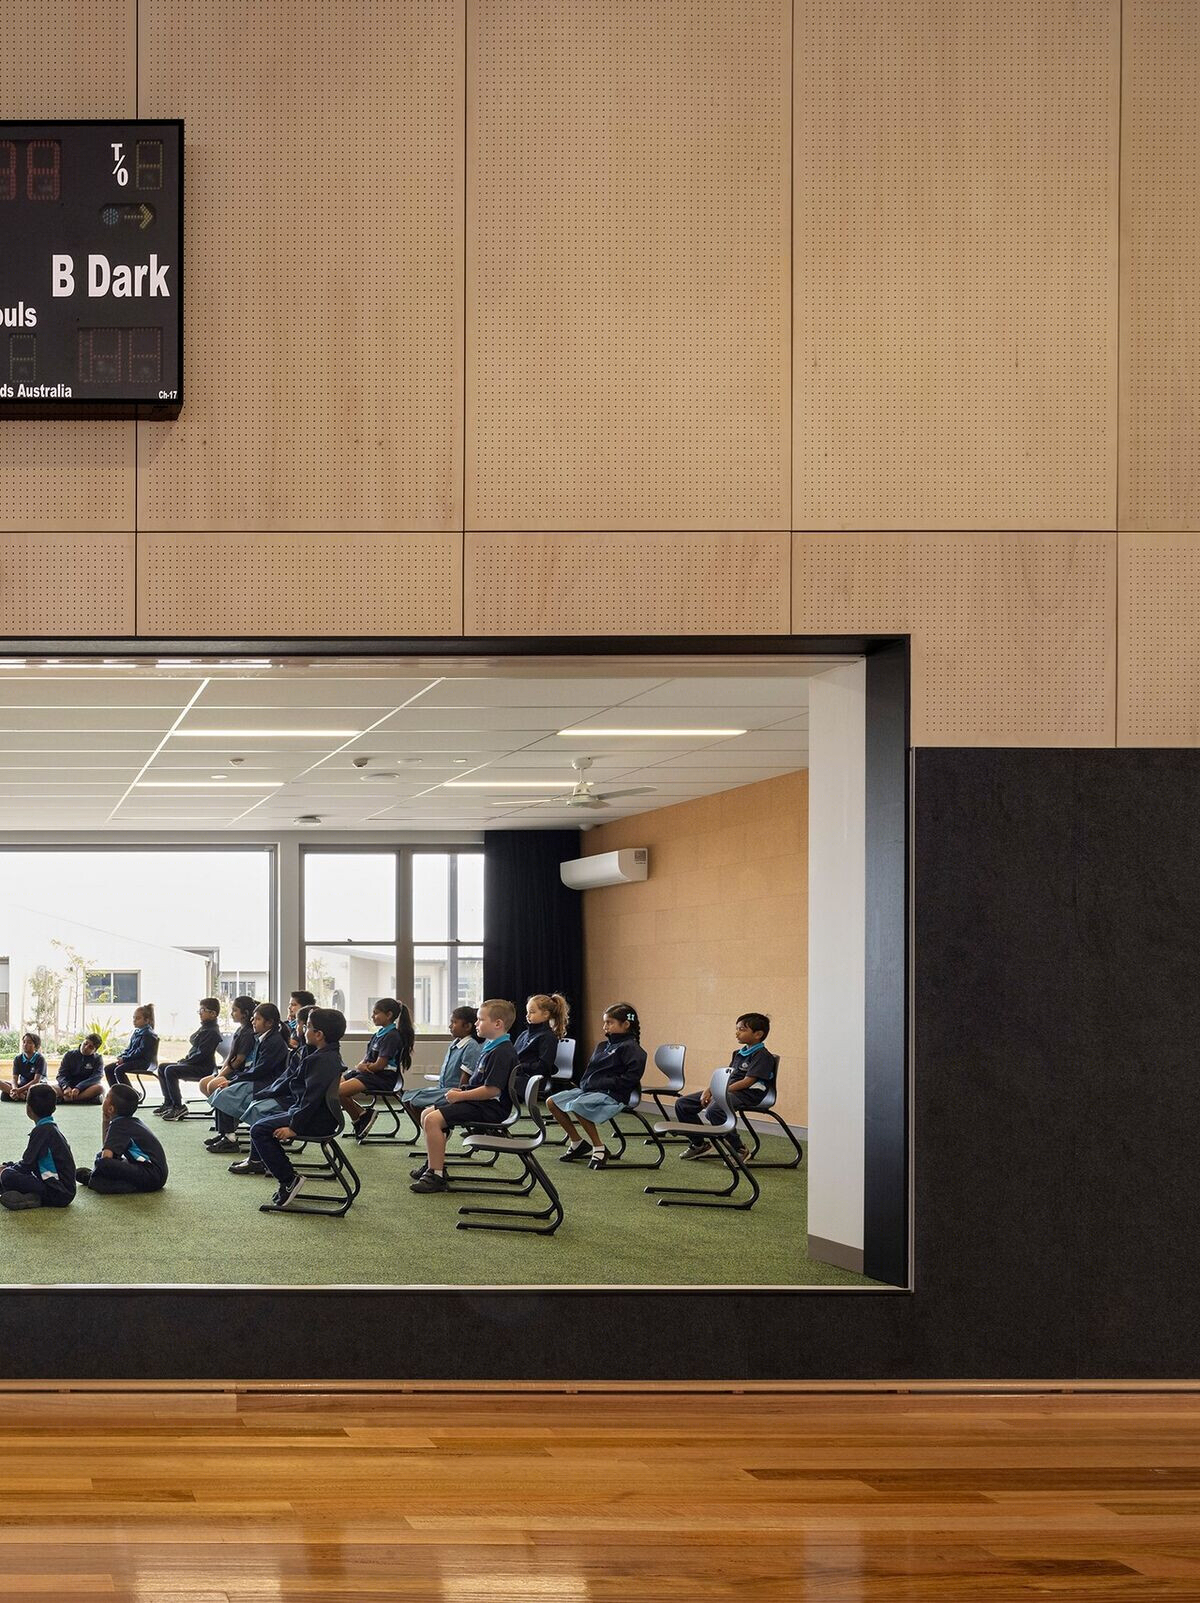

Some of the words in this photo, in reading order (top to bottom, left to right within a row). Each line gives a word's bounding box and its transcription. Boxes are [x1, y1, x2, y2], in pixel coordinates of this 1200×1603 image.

[52, 254, 75, 298] B
[88, 254, 170, 298] Dark
[17, 383, 72, 398] Australia
[158, 390, 178, 399] Ch-17
